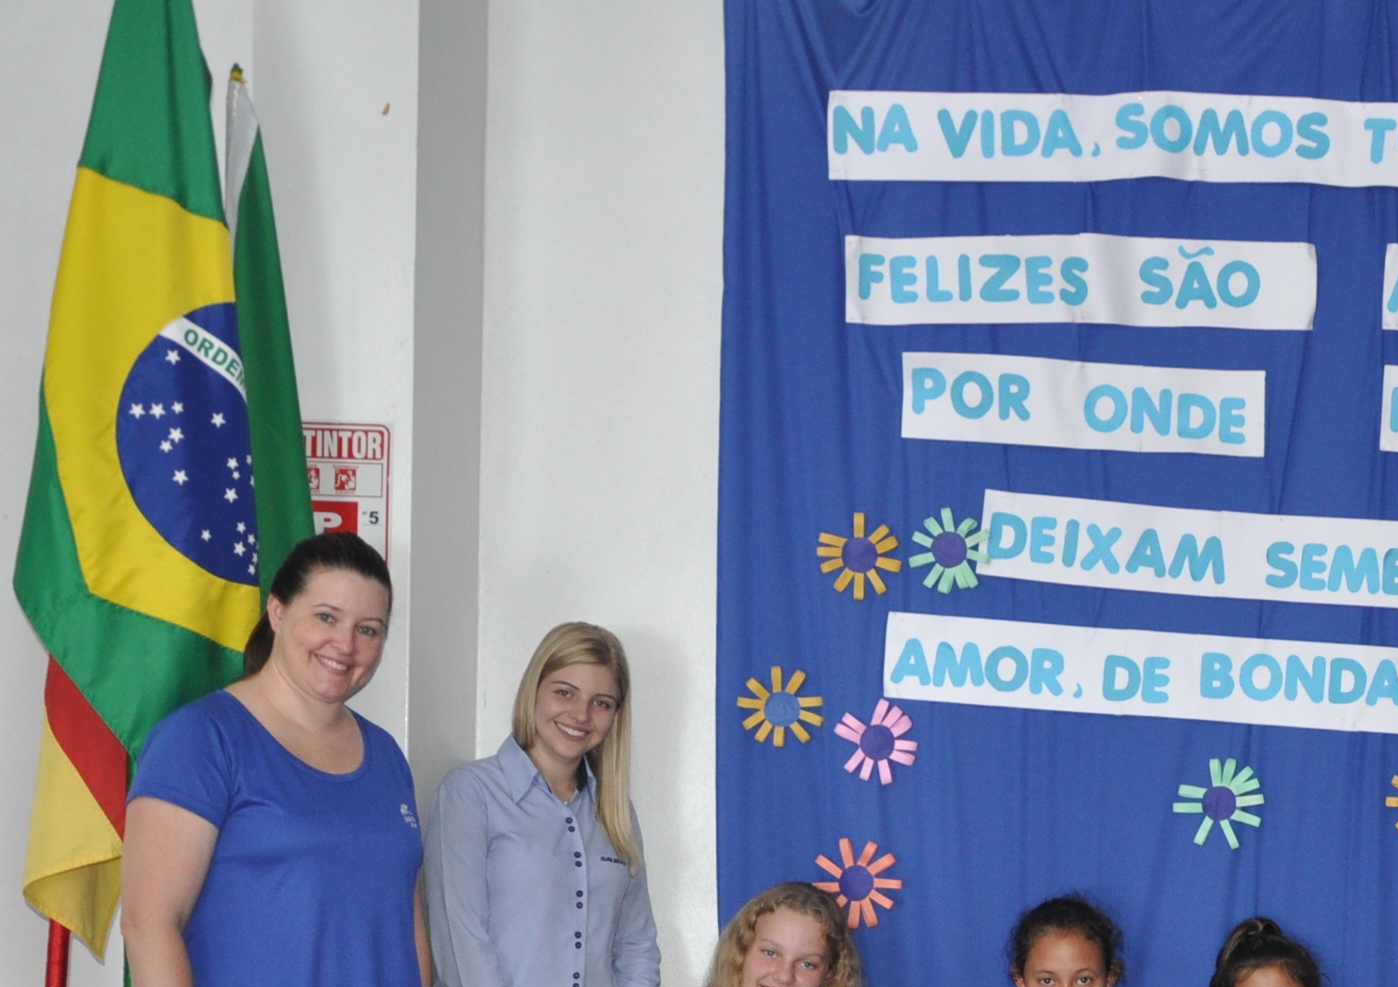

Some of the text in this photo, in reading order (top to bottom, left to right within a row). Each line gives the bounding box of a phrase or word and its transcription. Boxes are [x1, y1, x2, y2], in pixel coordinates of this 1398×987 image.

[834, 104, 918, 154] NA
[938, 109, 1100, 158] VIDA,
[1116, 103, 1330, 159] SOMOS
[859, 254, 1088, 306] FELIZES
[1140, 247, 1260, 309] SÃO
[912, 368, 1030, 420] POR
[1084, 384, 1245, 444] ONDE
[303, 429, 382, 459] TINTOR
[368, 511, 380, 525] 5
[987, 512, 1225, 584] DEIXAM
[891, 638, 1082, 698] AMOR,
[1103, 655, 1170, 703] DE
